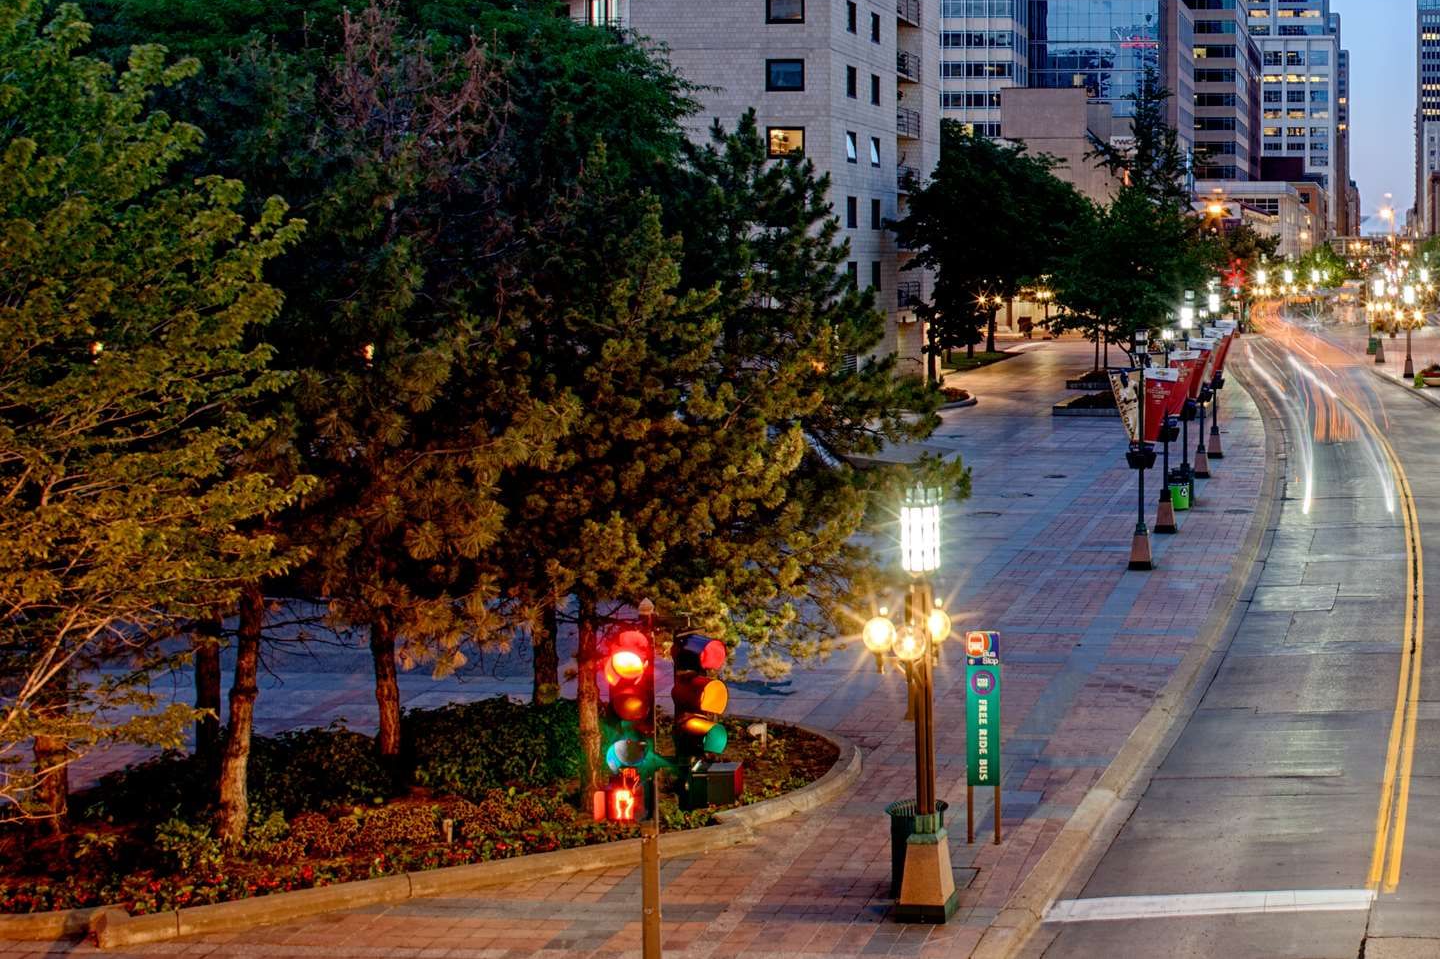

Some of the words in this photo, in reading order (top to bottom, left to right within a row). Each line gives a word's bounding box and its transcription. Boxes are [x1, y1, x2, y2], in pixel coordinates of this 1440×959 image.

[982, 657, 999, 665] Stop
[978, 699, 988, 725] FREE
[978, 728, 988, 754] RIDE
[978, 758, 988, 781] BUS
